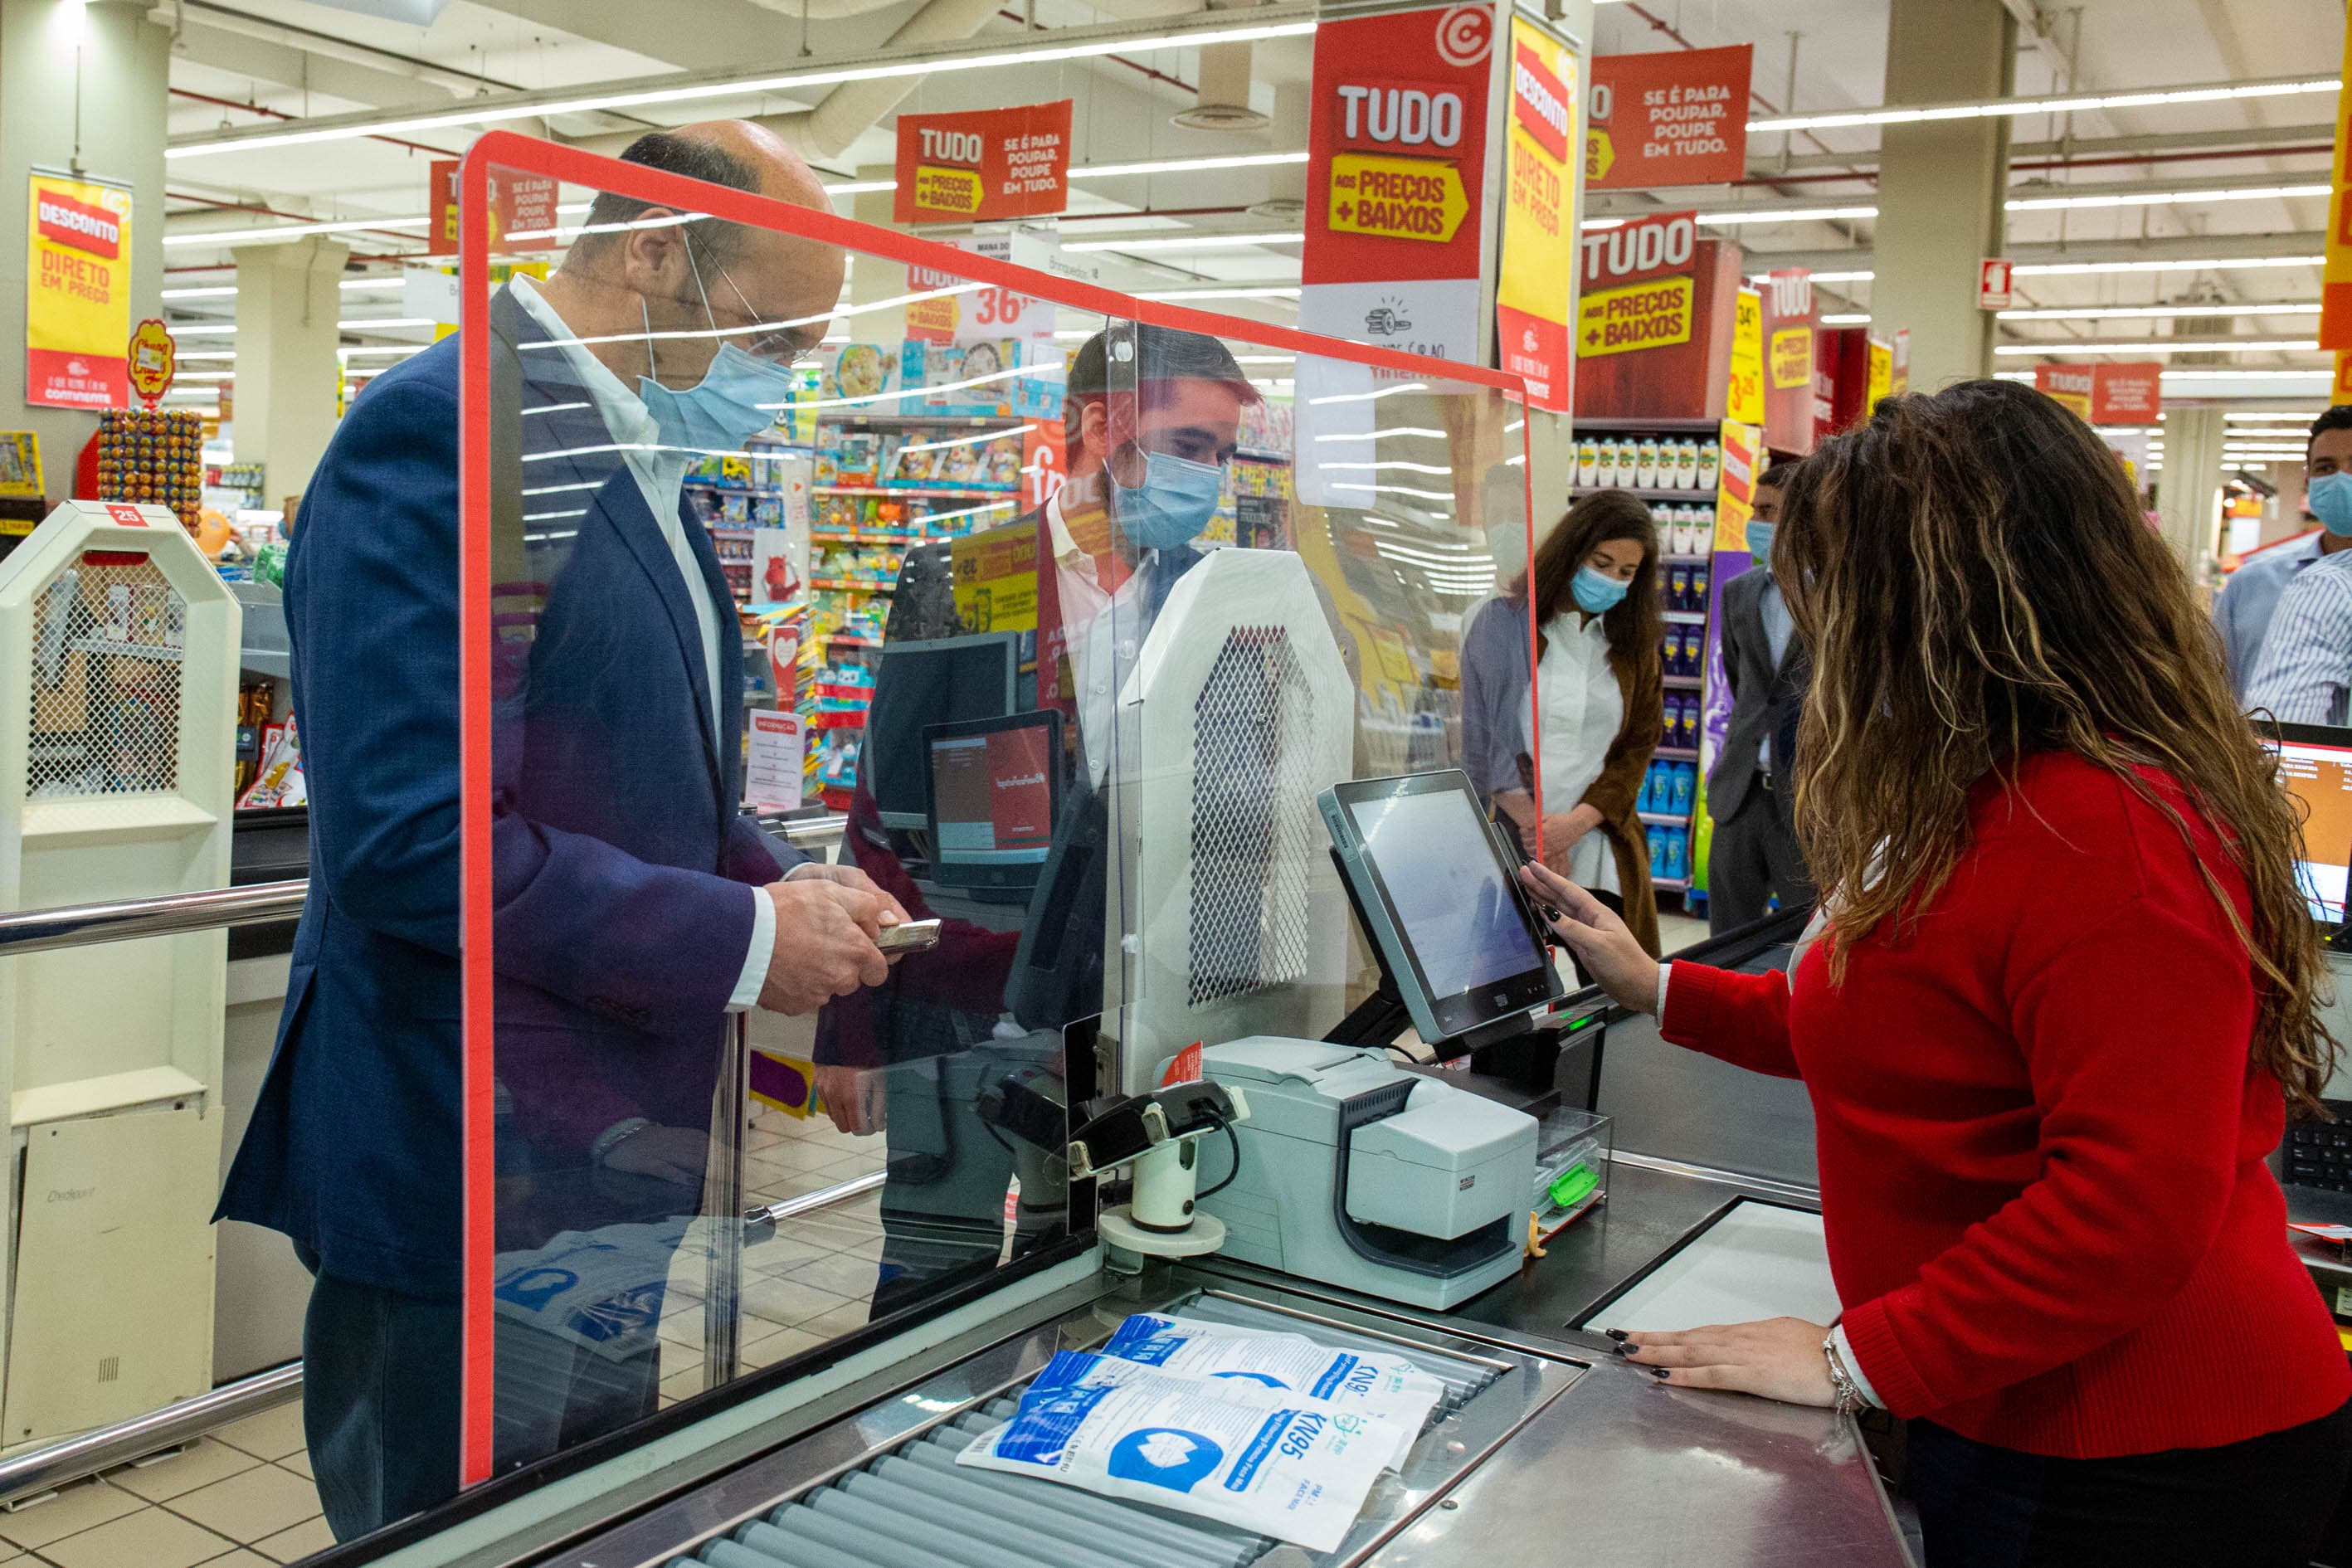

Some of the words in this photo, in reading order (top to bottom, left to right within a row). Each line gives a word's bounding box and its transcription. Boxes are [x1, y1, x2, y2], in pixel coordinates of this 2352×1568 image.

[1516, 61, 1568, 138] DESCONTO
[1644, 90, 1667, 106] SE
[1670, 85, 1681, 105] É
[1685, 85, 1731, 102] PARA
[1337, 85, 1463, 148] TUDO
[1655, 121, 1717, 139] POUPE
[918, 128, 983, 163] TUDO
[1005, 138, 1019, 151] SE
[1022, 134, 1029, 149] É
[1031, 134, 1060, 148] PARA
[1643, 142, 1670, 158] EM
[1674, 138, 1728, 156] TUDO.
[1003, 182, 1021, 194] EM
[1010, 163, 1051, 179] POUPE
[1359, 169, 1446, 204] PREÇOS
[1514, 139, 1561, 209] DIRETO
[930, 191, 973, 209] BAIXOS
[1357, 199, 1445, 236] BAIXOS
[39, 201, 119, 244] DESCONTO
[1582, 217, 1694, 280] TUDO
[41, 249, 110, 289] DIRETO
[41, 272, 62, 290] EM
[69, 280, 110, 305] PREÇO
[1607, 287, 1685, 320] PREÇOS
[1605, 312, 1683, 348] BAIXOS
[114, 509, 140, 522] 25
[1280, 1411, 1327, 1460] KN95
